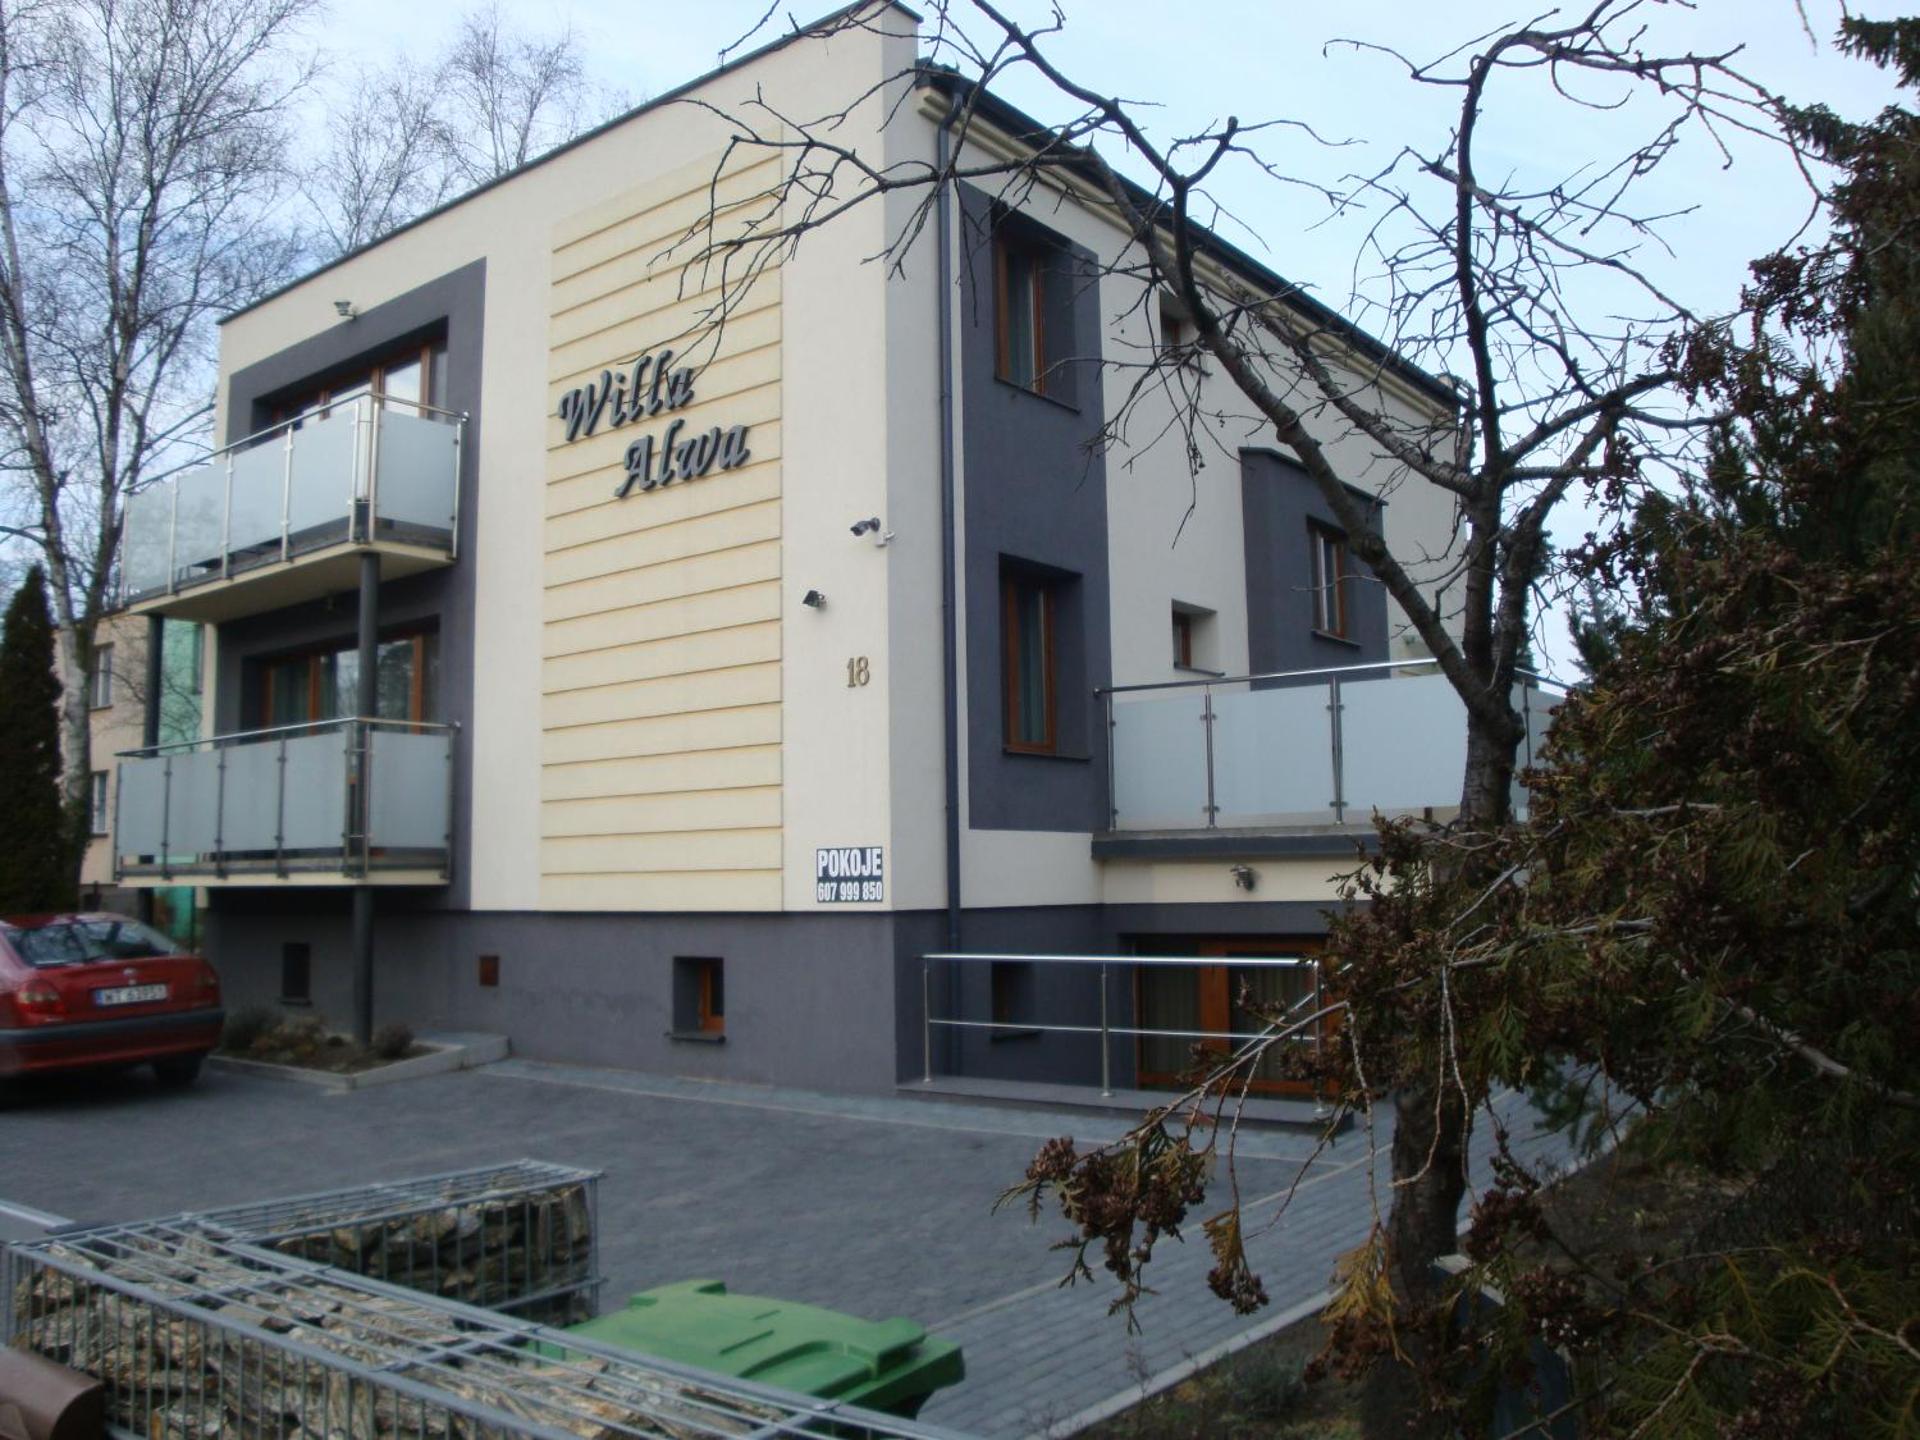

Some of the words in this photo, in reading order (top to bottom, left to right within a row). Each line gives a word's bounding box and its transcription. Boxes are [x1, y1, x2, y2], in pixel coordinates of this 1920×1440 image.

[558, 350, 694, 441] Willa
[614, 418, 750, 498] Alwa
[847, 656, 870, 688] 18
[817, 848, 882, 877] POKOJE
[817, 882, 837, 901] 607
[840, 881, 860, 901] 999
[862, 880, 883, 900] 850
